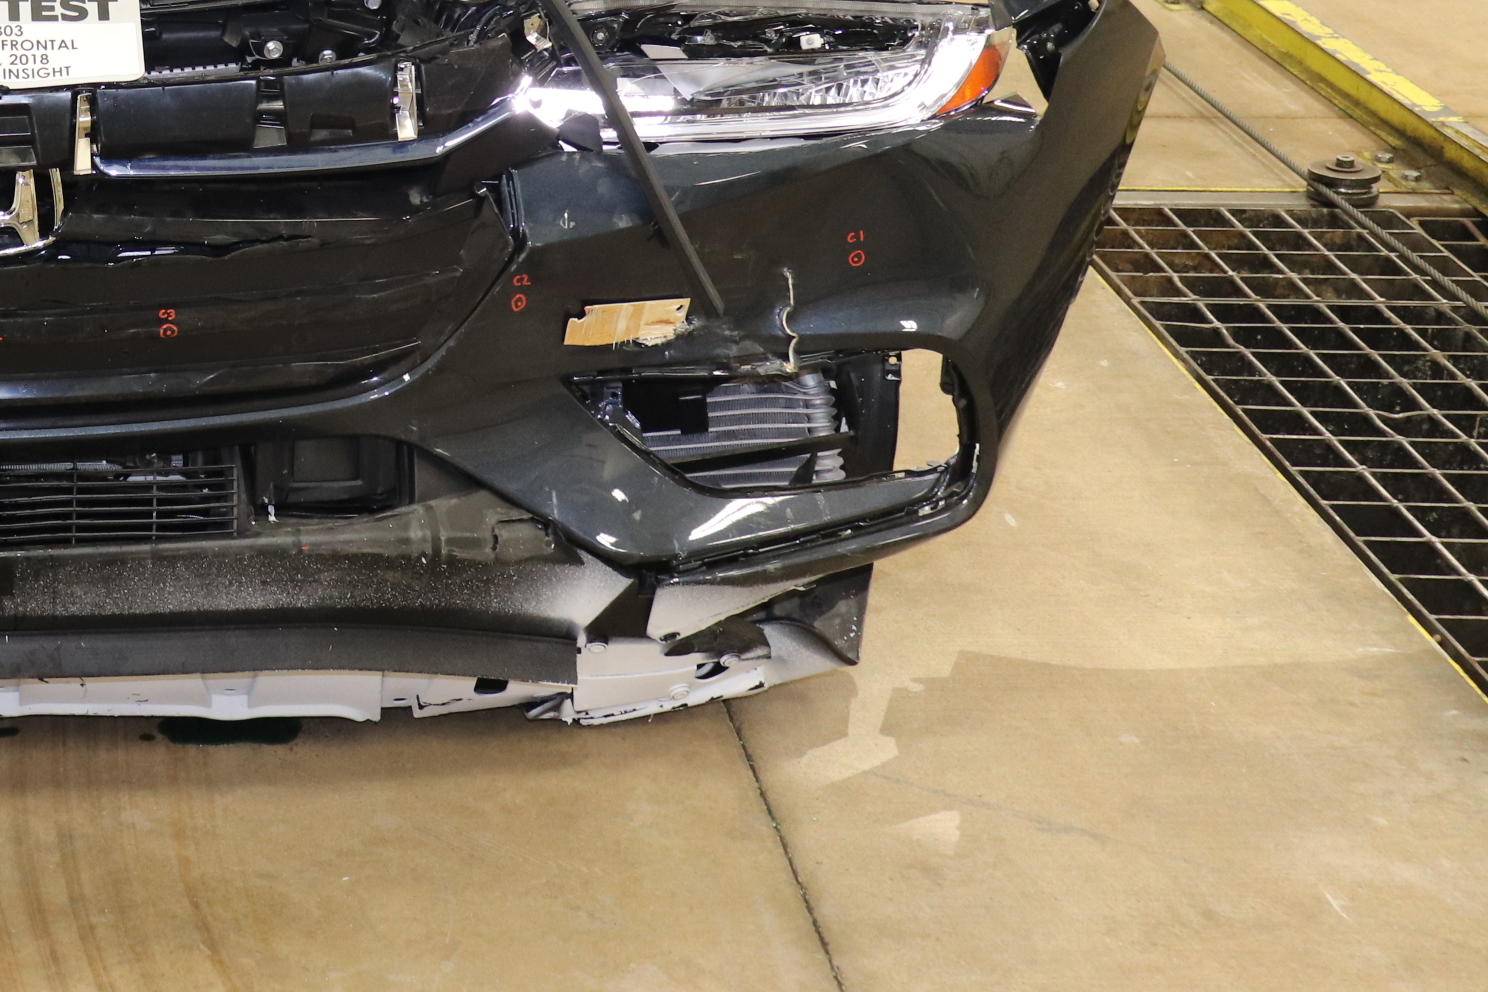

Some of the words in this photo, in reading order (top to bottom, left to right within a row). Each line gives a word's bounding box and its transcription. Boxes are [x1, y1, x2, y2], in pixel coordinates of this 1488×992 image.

[1, 39, 78, 51] FRONTAL
[9, 53, 50, 66] 2018
[2, 66, 71, 79] INSIGHT
[512, 273, 532, 287] C2
